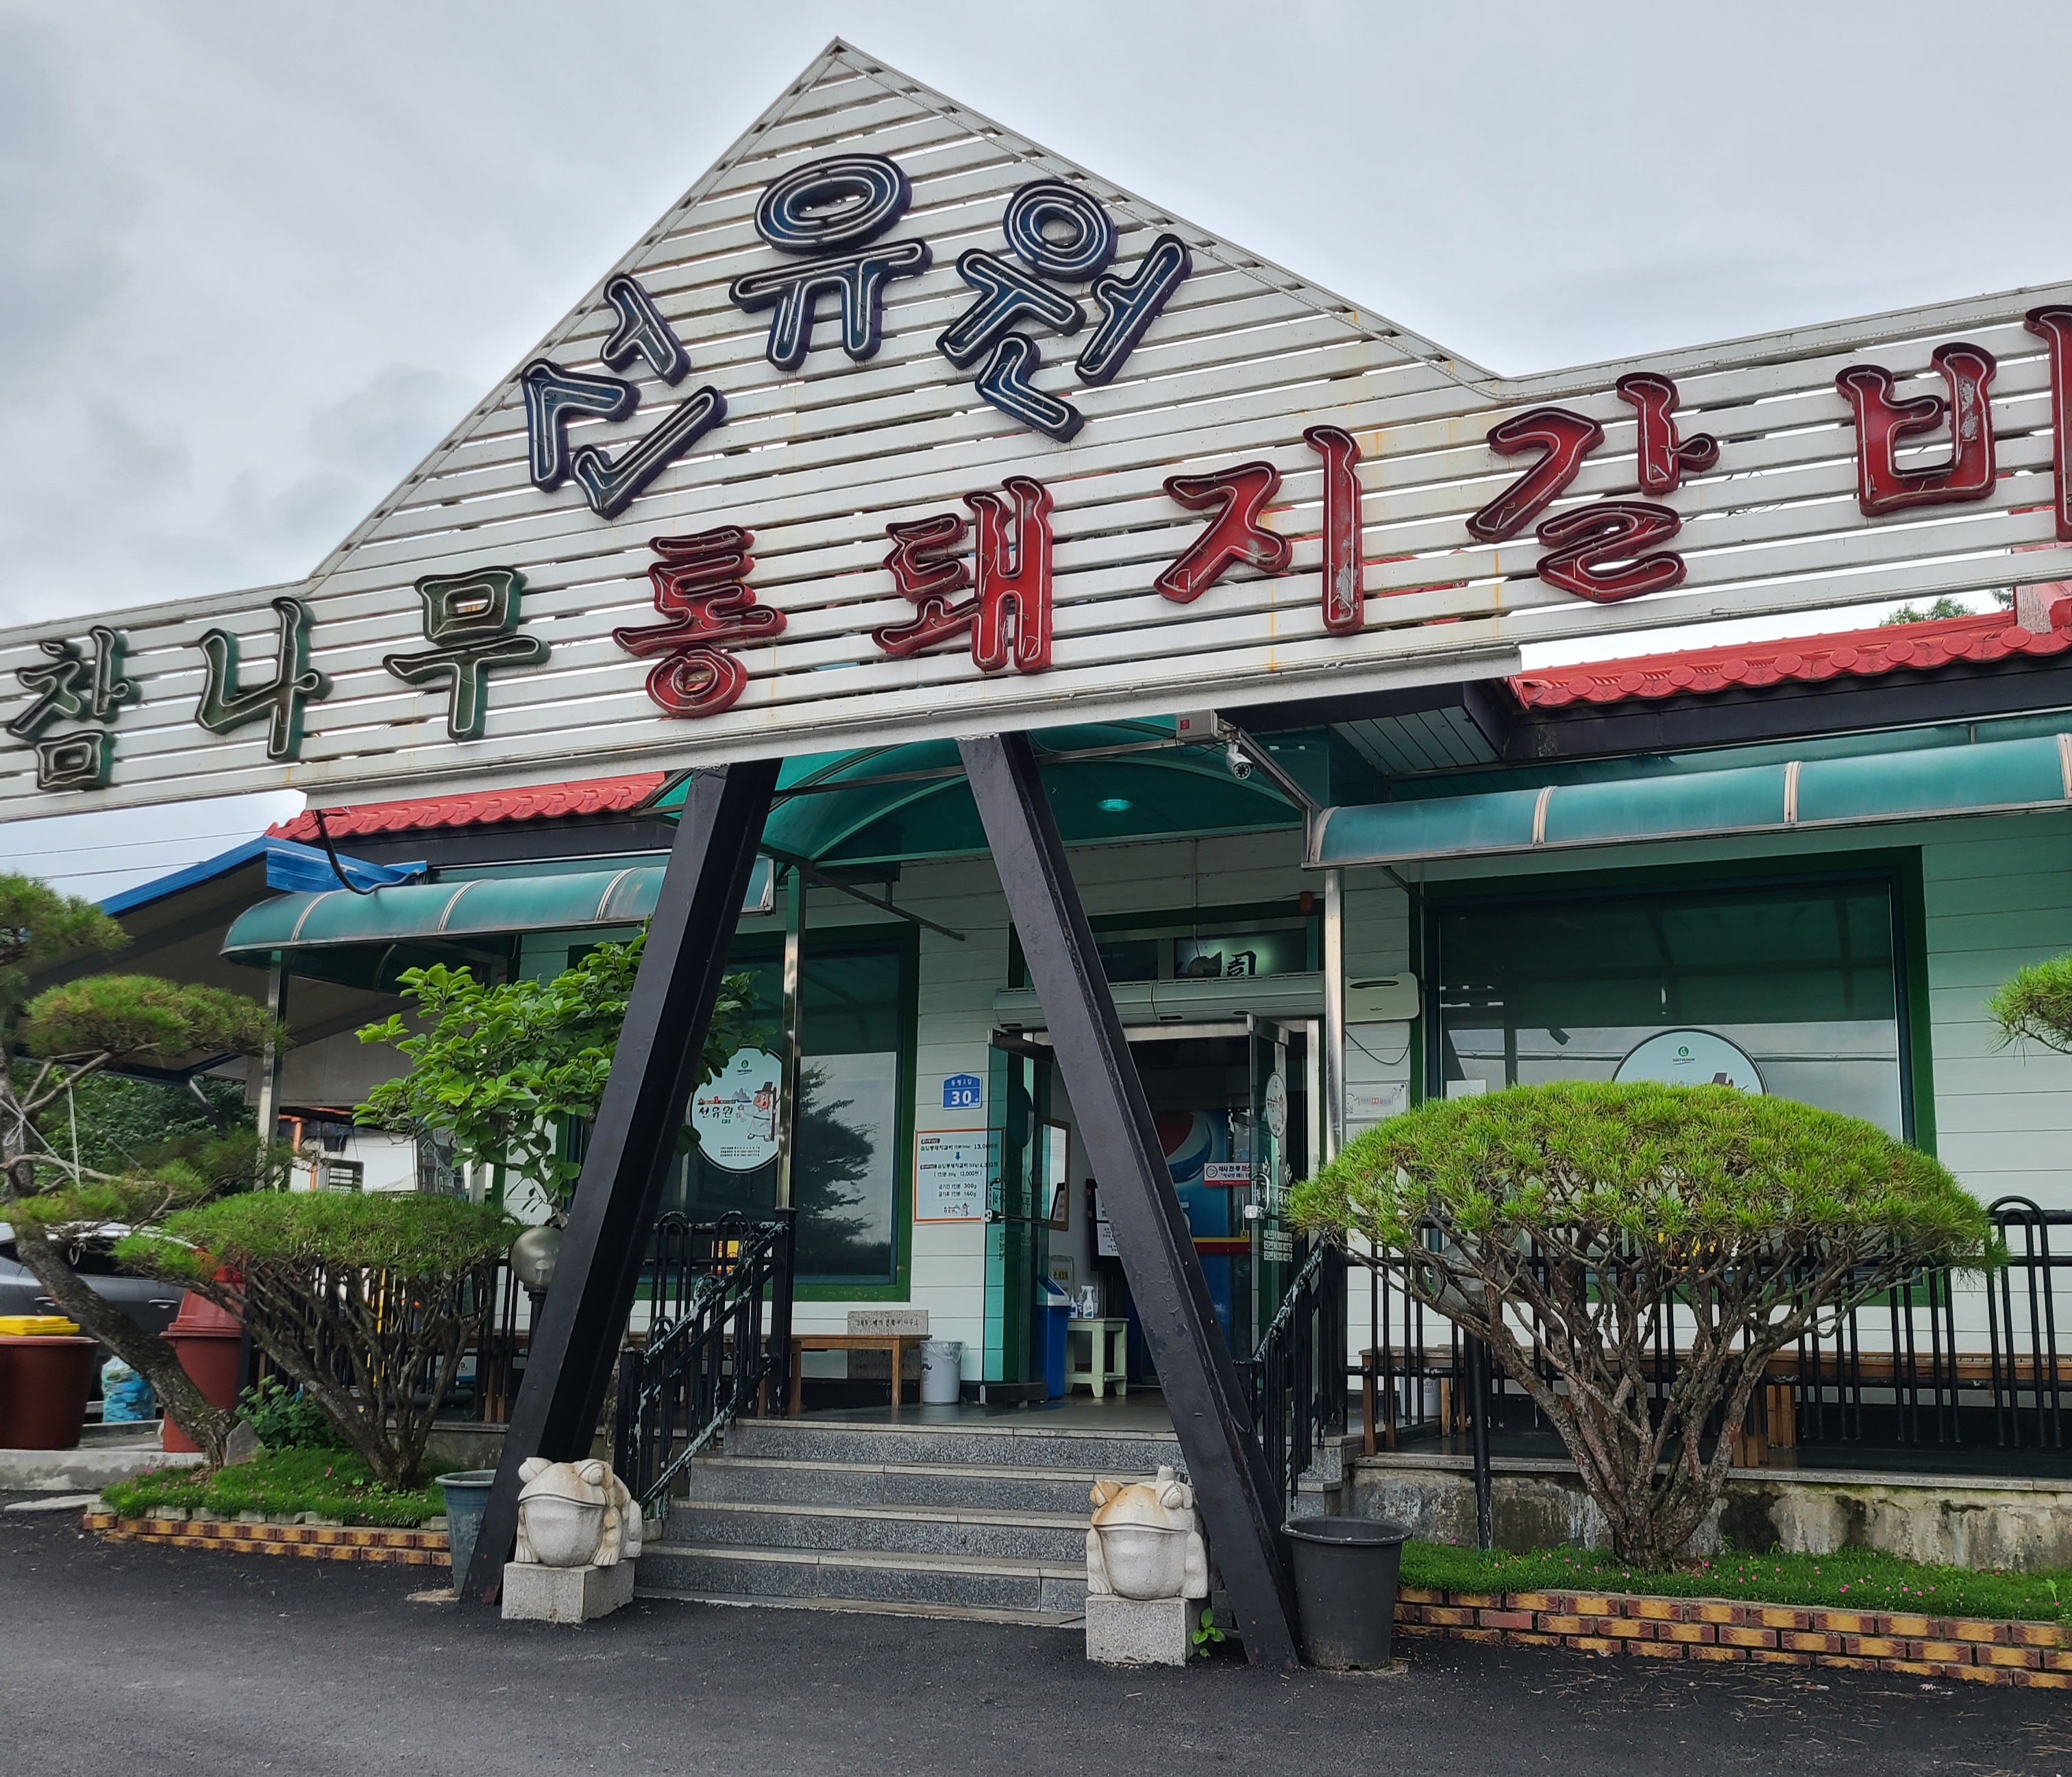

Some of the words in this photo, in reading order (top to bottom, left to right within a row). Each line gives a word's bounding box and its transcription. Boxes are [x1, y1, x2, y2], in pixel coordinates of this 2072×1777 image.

[520, 153, 1194, 519] 선유원
[950, 1090, 972, 1105] 30
[699, 1105, 733, 1118] 선유원
